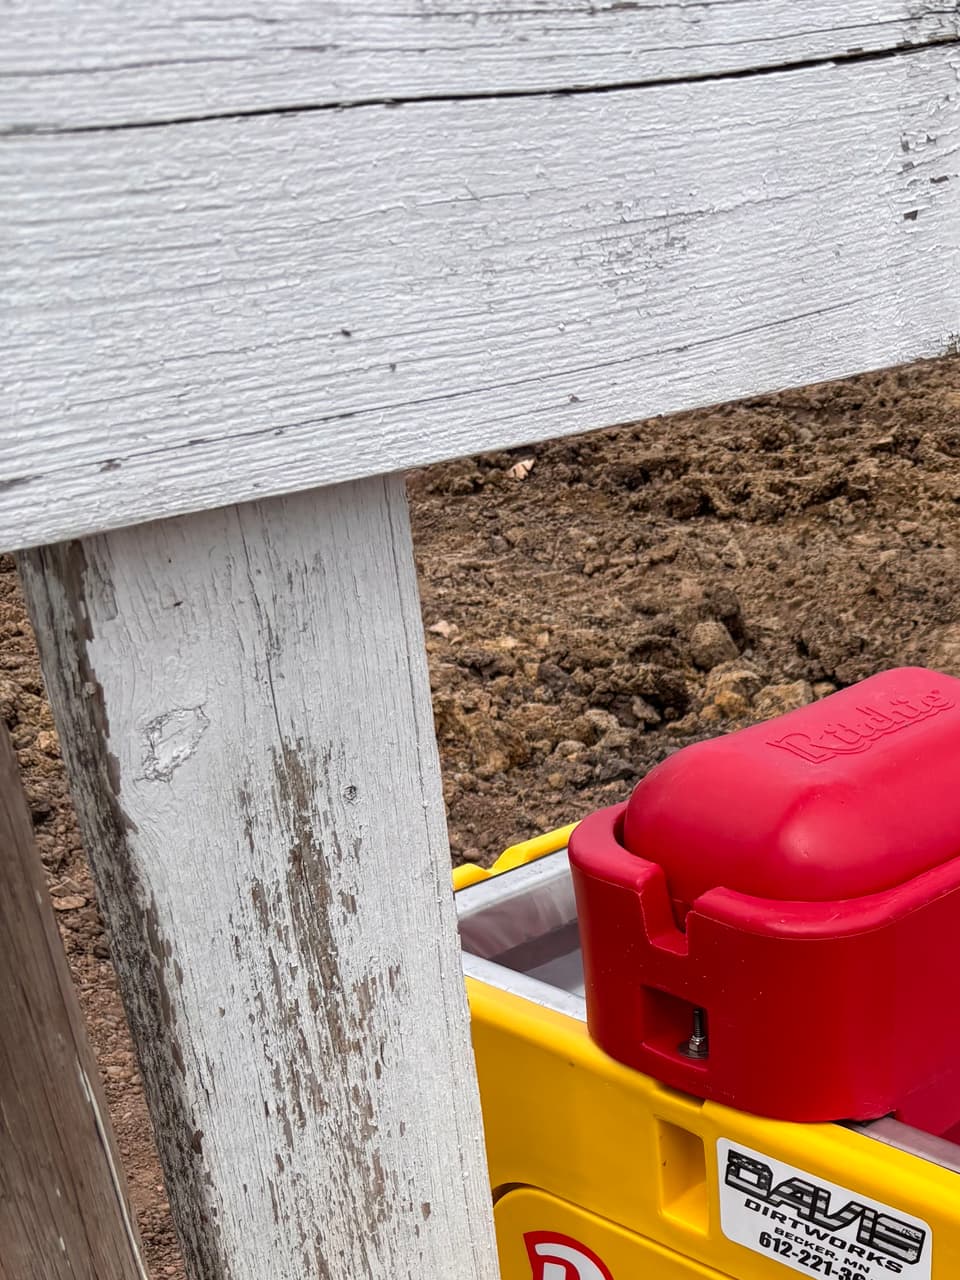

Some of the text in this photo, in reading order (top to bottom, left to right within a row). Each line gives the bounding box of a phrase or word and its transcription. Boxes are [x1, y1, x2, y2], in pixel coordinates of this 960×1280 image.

[768, 691, 953, 763] Ritchie
[725, 1149, 926, 1265] DAVIS
[744, 1199, 903, 1274] DIRTWORKS
[844, 1257, 870, 1274] MN
